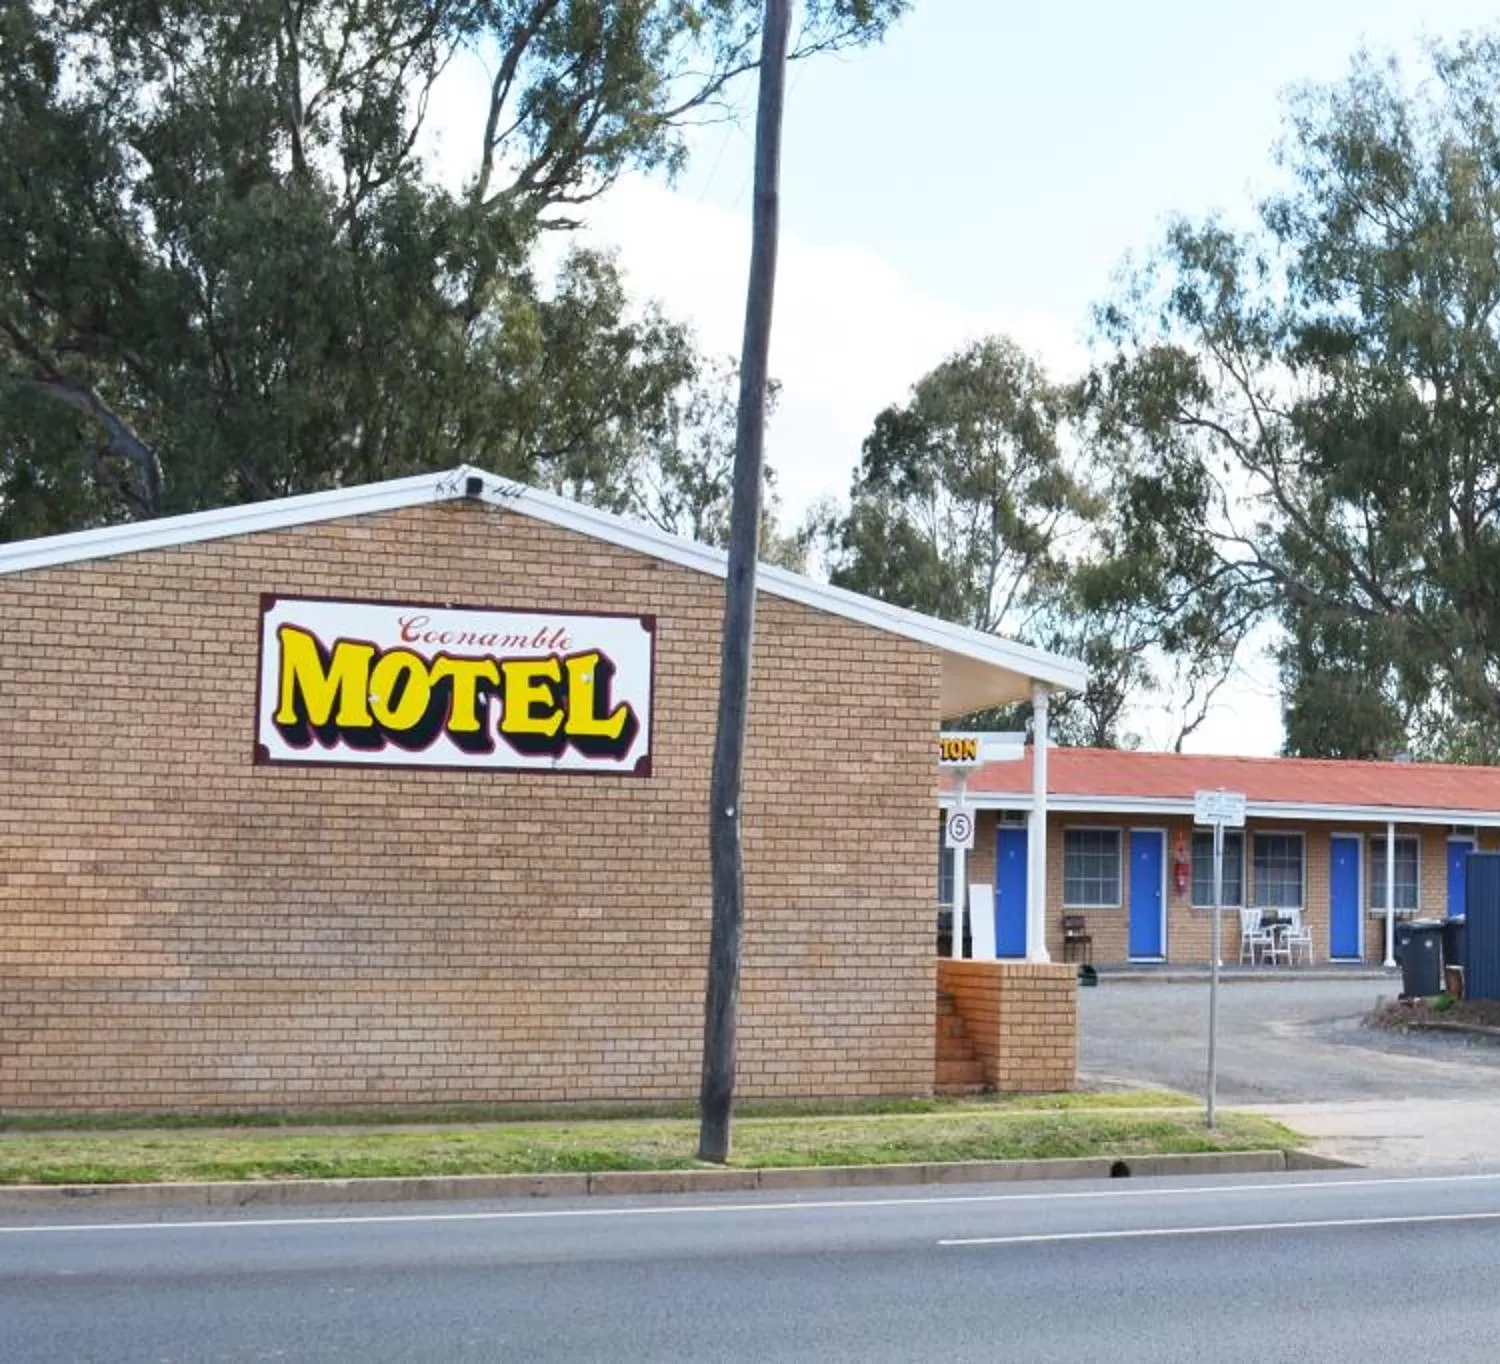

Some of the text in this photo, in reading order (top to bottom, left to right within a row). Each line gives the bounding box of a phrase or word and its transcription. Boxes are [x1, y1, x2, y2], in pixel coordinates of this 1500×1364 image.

[397, 615, 573, 651] Coonamble
[273, 623, 640, 761] MOTEL
[955, 819, 965, 836] 5
